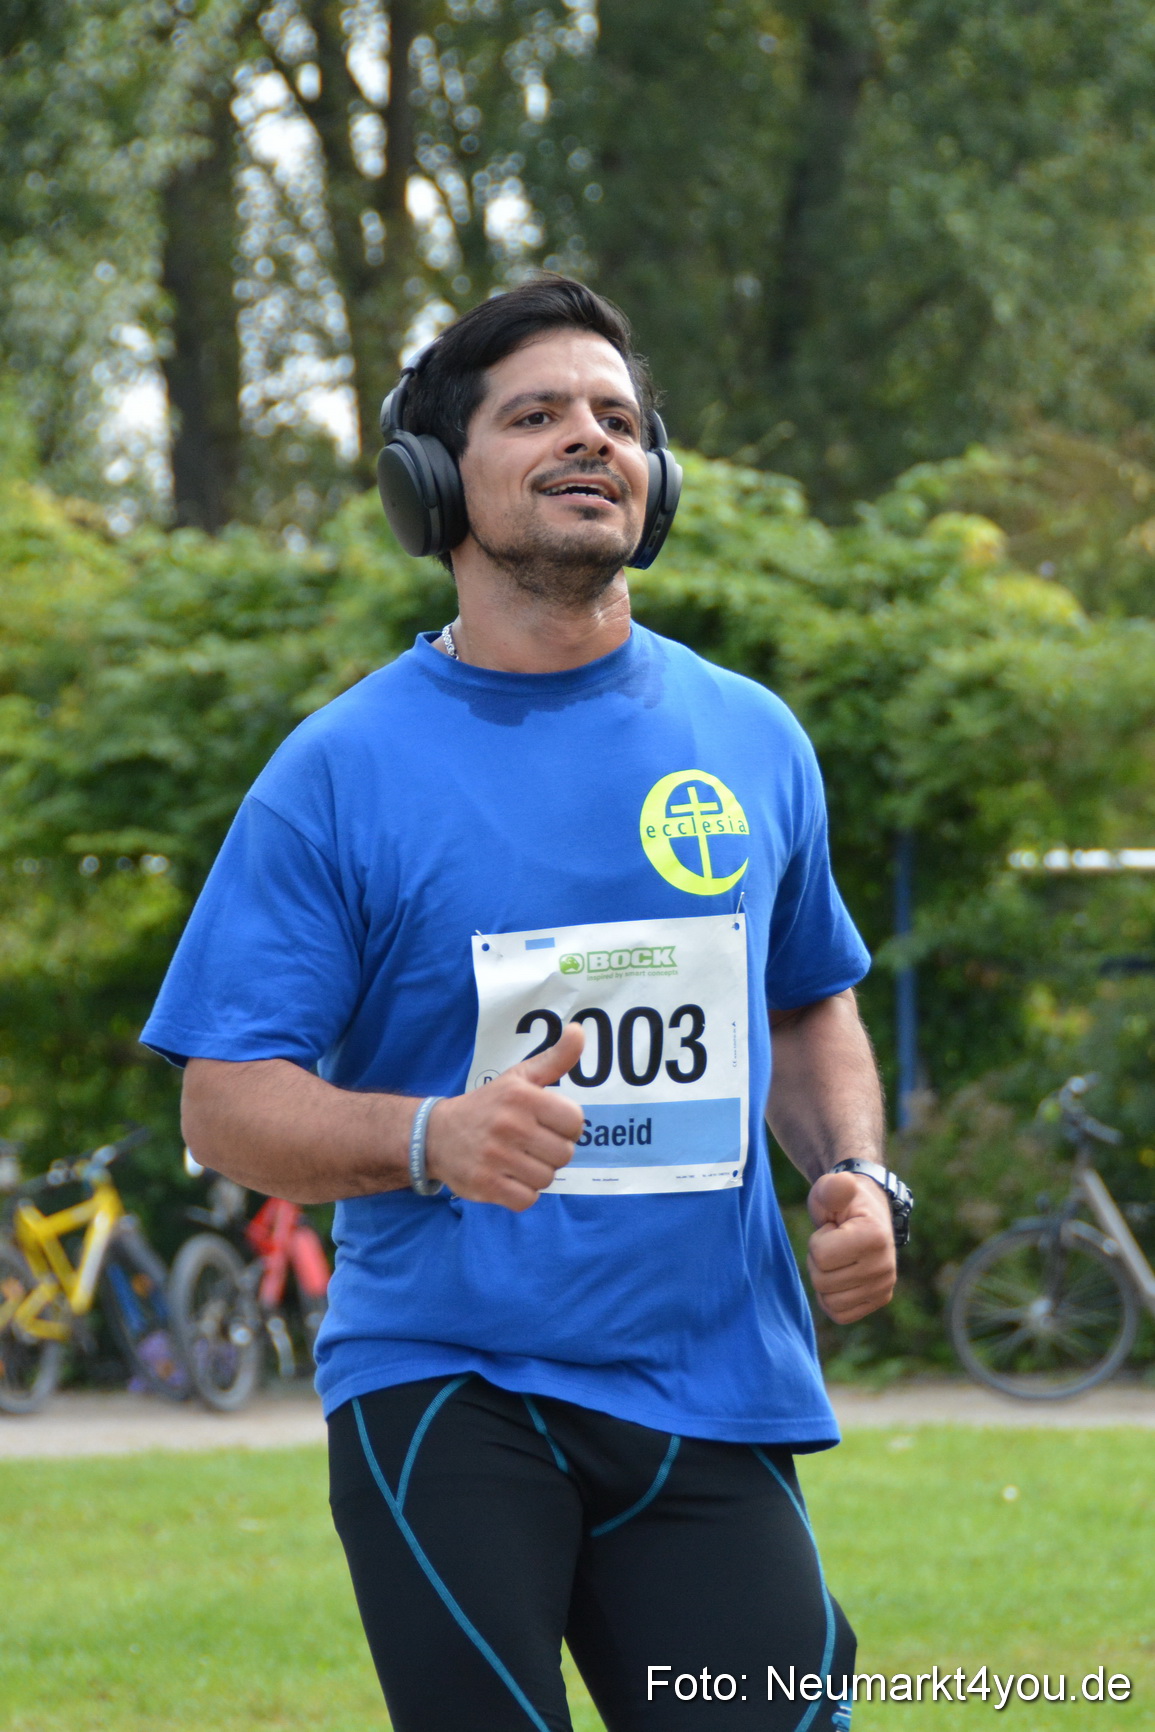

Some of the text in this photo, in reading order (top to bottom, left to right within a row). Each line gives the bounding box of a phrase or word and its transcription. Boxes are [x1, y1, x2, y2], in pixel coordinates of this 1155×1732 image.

[646, 815, 747, 838] ecclesia
[587, 946, 677, 973] BOCK
[647, 969, 678, 977] concepts
[515, 1004, 708, 1088] 2003
[575, 1118, 652, 1147] Saeid
